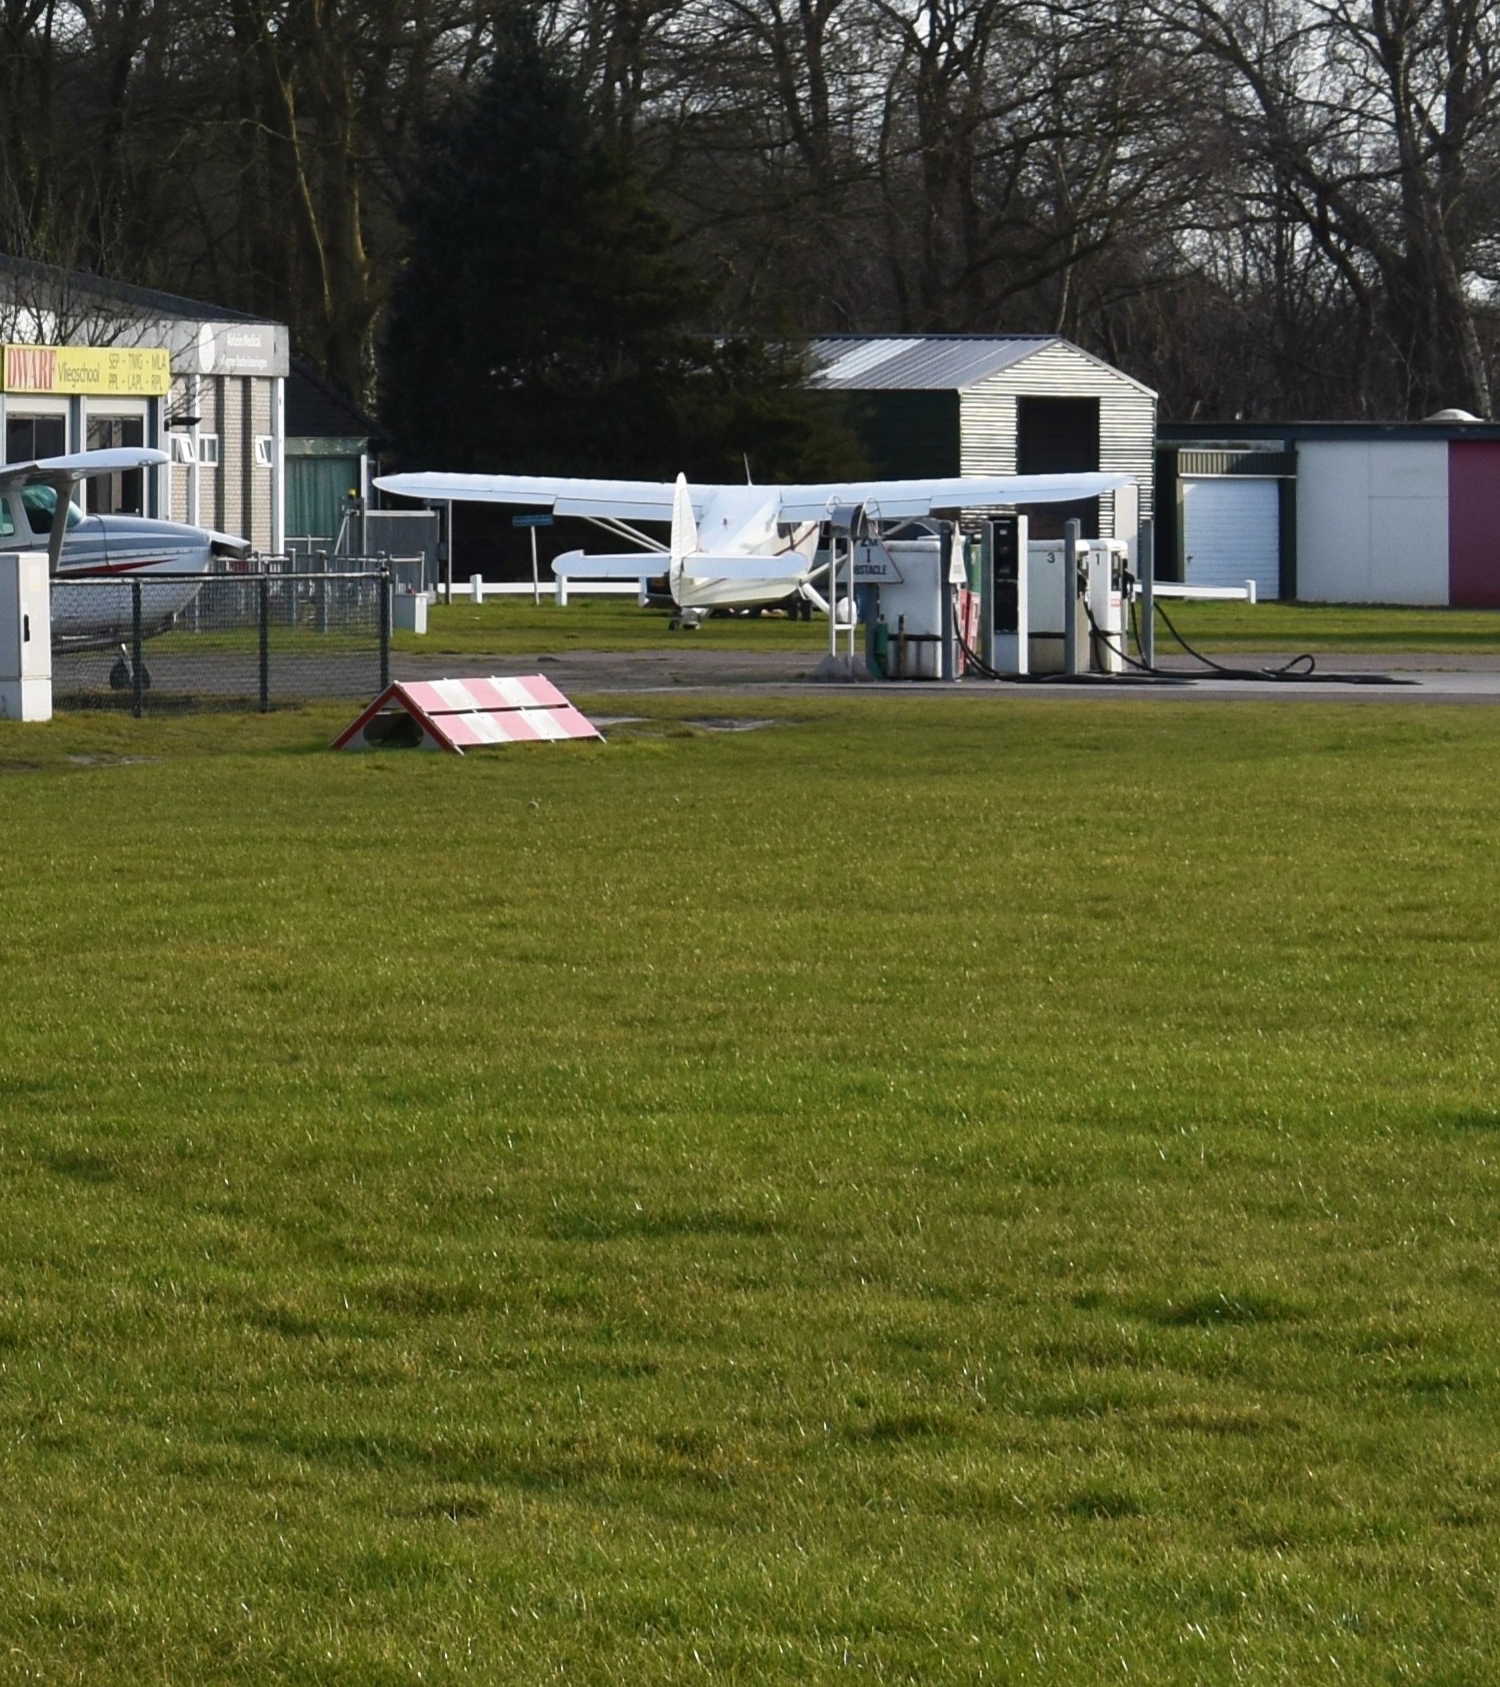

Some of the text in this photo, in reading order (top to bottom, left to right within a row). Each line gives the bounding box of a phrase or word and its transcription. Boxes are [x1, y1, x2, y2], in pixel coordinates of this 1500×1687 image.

[7, 348, 57, 390] DWARF
[108, 353, 120, 370] SEP
[58, 362, 100, 388] Vliegschool
[1047, 552, 1055, 564] 3
[1095, 553, 1100, 566] 1
[854, 564, 886, 575] BSTACLE
